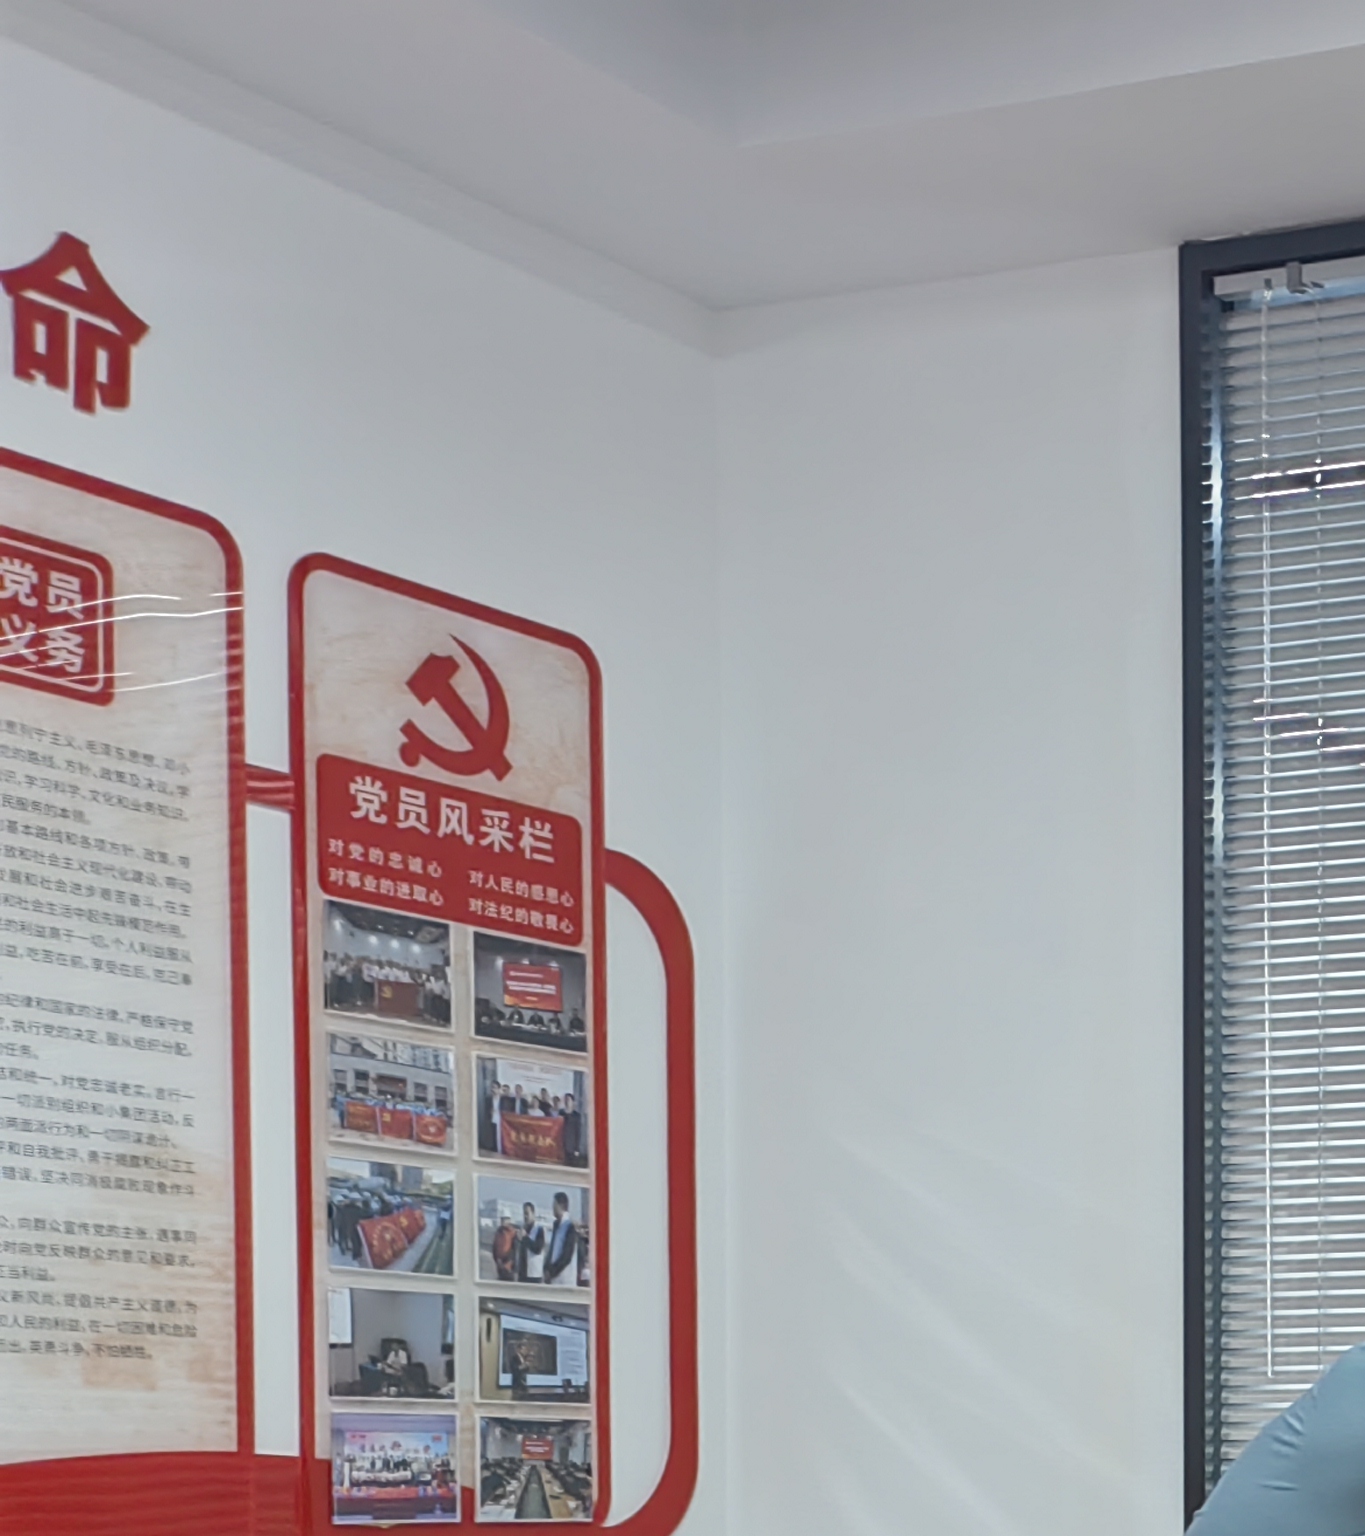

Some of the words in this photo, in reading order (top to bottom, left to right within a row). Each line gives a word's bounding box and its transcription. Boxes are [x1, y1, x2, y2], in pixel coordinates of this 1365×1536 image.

[0, 231, 150, 414] 命
[0, 555, 84, 620] 党员
[0, 613, 85, 673] 义务
[349, 776, 555, 863] 党员风采栏
[328, 838, 442, 878] 对党的忠诚心
[328, 867, 444, 906] 对事业的进取心
[468, 870, 574, 907] 对人民的感恩心
